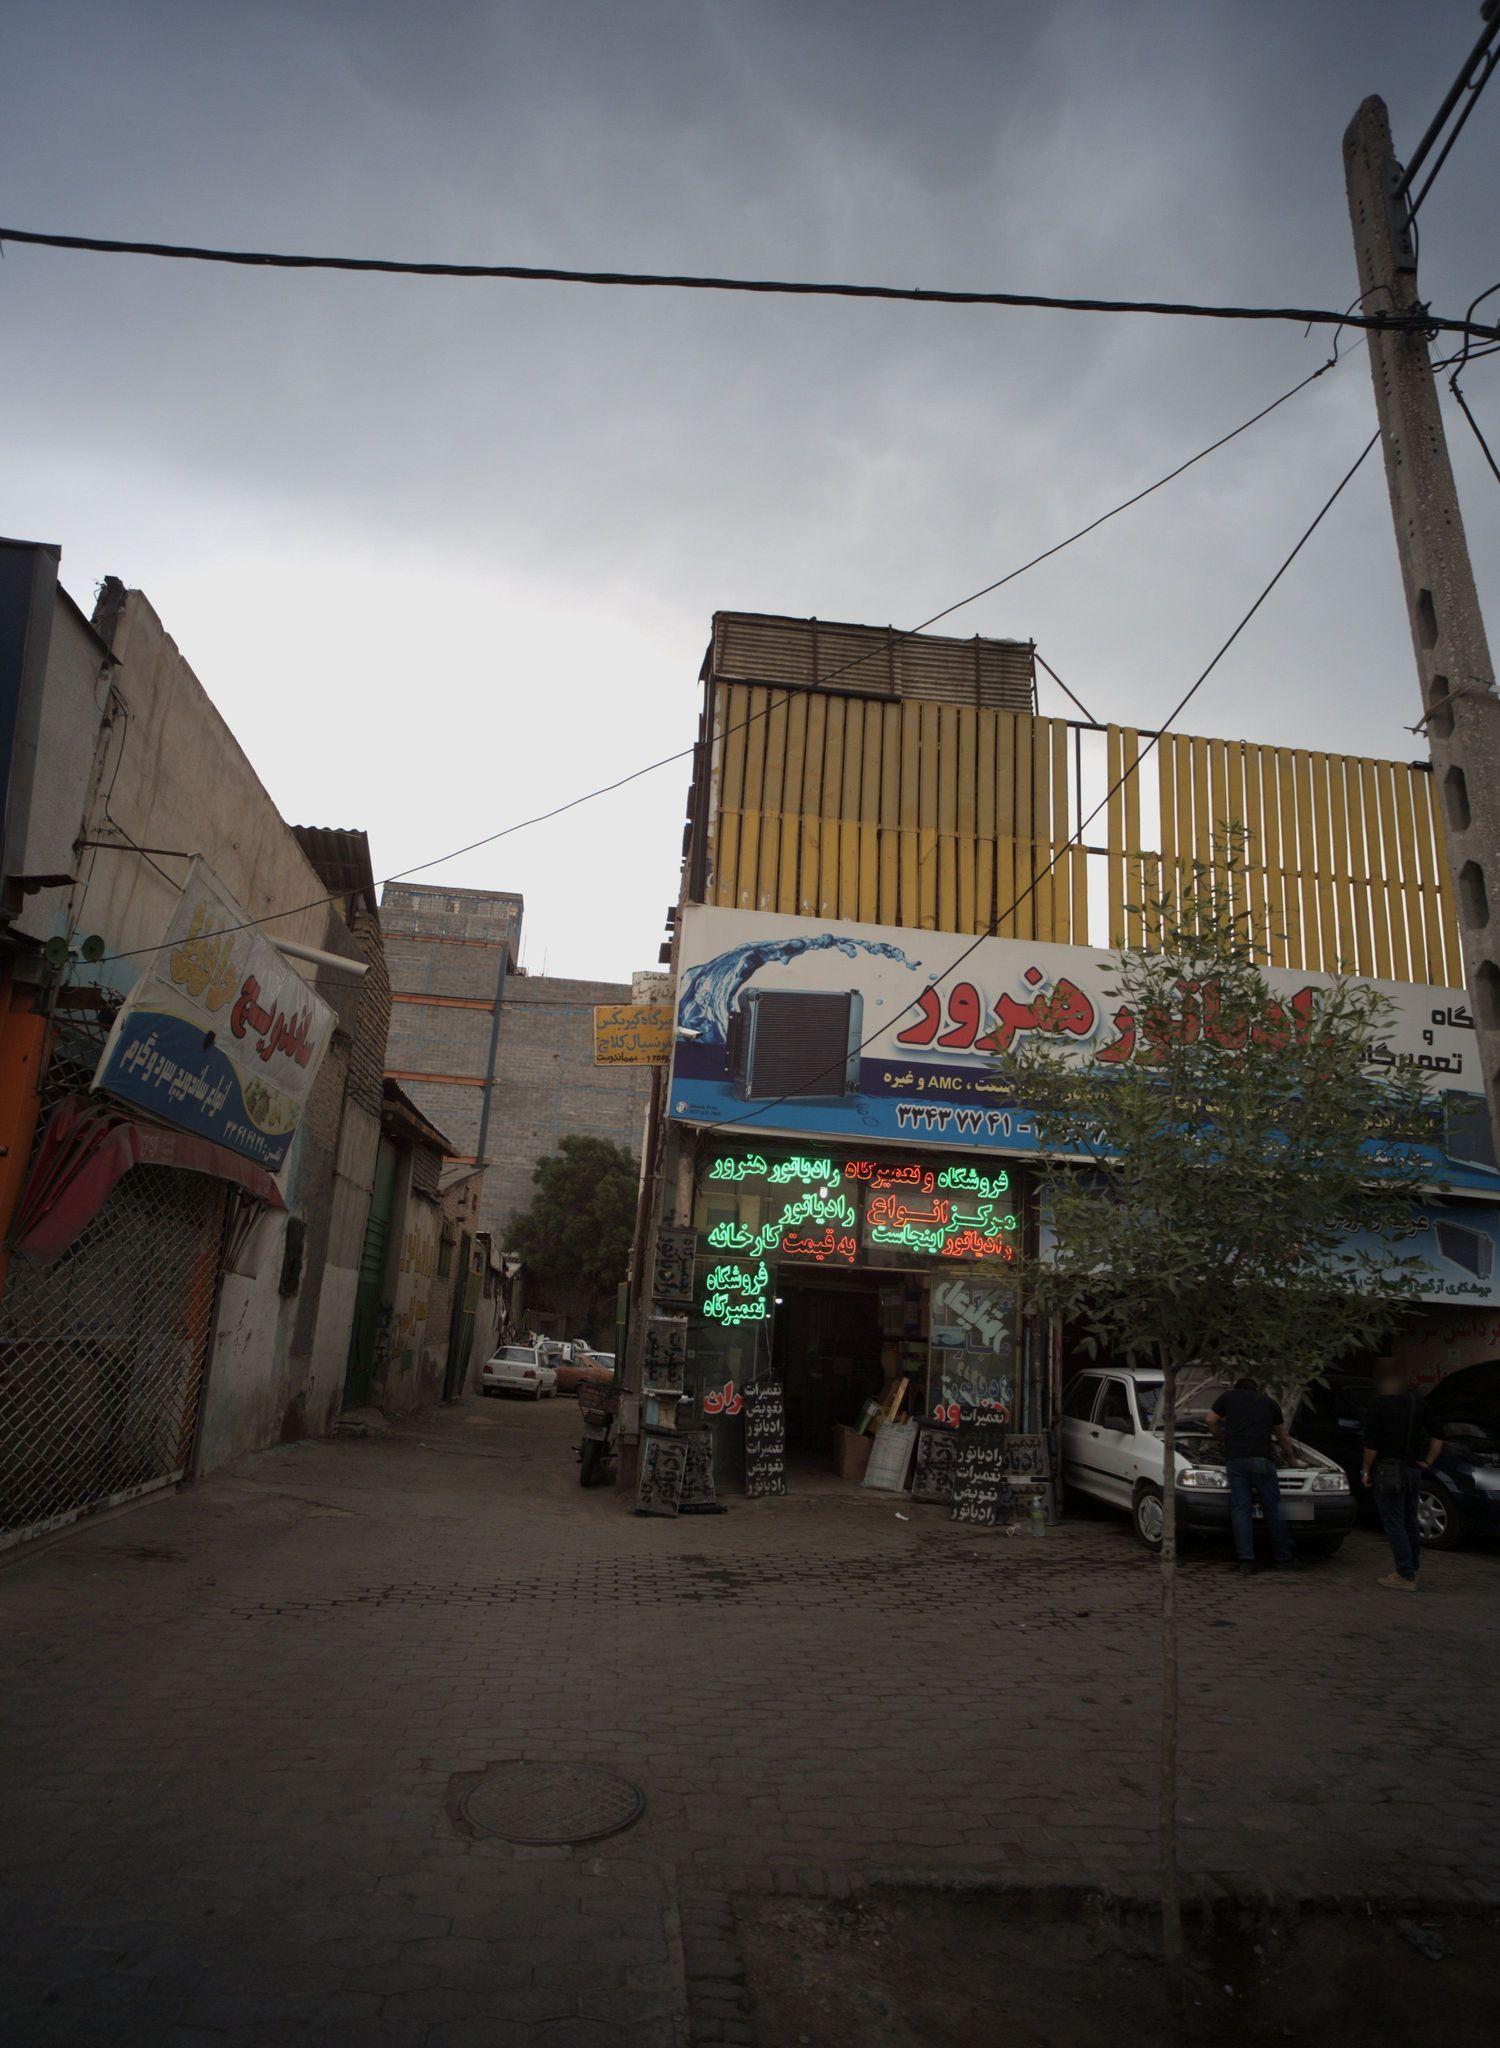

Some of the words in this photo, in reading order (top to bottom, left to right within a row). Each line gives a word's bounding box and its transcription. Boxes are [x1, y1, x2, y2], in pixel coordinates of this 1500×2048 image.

[897, 966, 1095, 1051] هنرور
[1096, 978, 1335, 1075] ادیاتور
[1423, 1030, 1434, 1046] و
[883, 1070, 914, 1089] غیره
[928, 1075, 963, 1091] AMC
[709, 1153, 767, 1180] هنرور
[768, 1156, 841, 1187] رادیاتور
[844, 1161, 922, 1188] تعمیرگاه
[922, 1173, 934, 1194] و
[938, 1167, 1008, 1198] فروشگاه
[779, 1193, 856, 1227] رادیاتور
[867, 1194, 947, 1228] انواع
[945, 1204, 1017, 1236] مرکز
[708, 1222, 781, 1257] کارخانه
[782, 1229, 836, 1262] قیمت
[837, 1236, 856, 1262] به
[871, 1224, 944, 1255] اینجاست
[941, 1231, 1013, 1261] رادیاتور
[706, 1261, 769, 1296] فروشگاه
[702, 1292, 766, 1327] تعمیرگاه
[704, 1380, 744, 1415] ران
[744, 1382, 782, 1400] تعمیرات
[746, 1400, 783, 1418] تعویض
[960, 1407, 1004, 1426] تعمیرات
[747, 1419, 784, 1437] رادیاتور
[746, 1439, 784, 1458] تعمیرات
[958, 1445, 1003, 1467] رادیاتور
[747, 1458, 784, 1477] تعویض
[957, 1464, 1001, 1484] تعمیرات
[747, 1477, 785, 1496] رادیاتور
[953, 1484, 998, 1505] تعویض
[952, 1503, 996, 1526] رادیاتور
